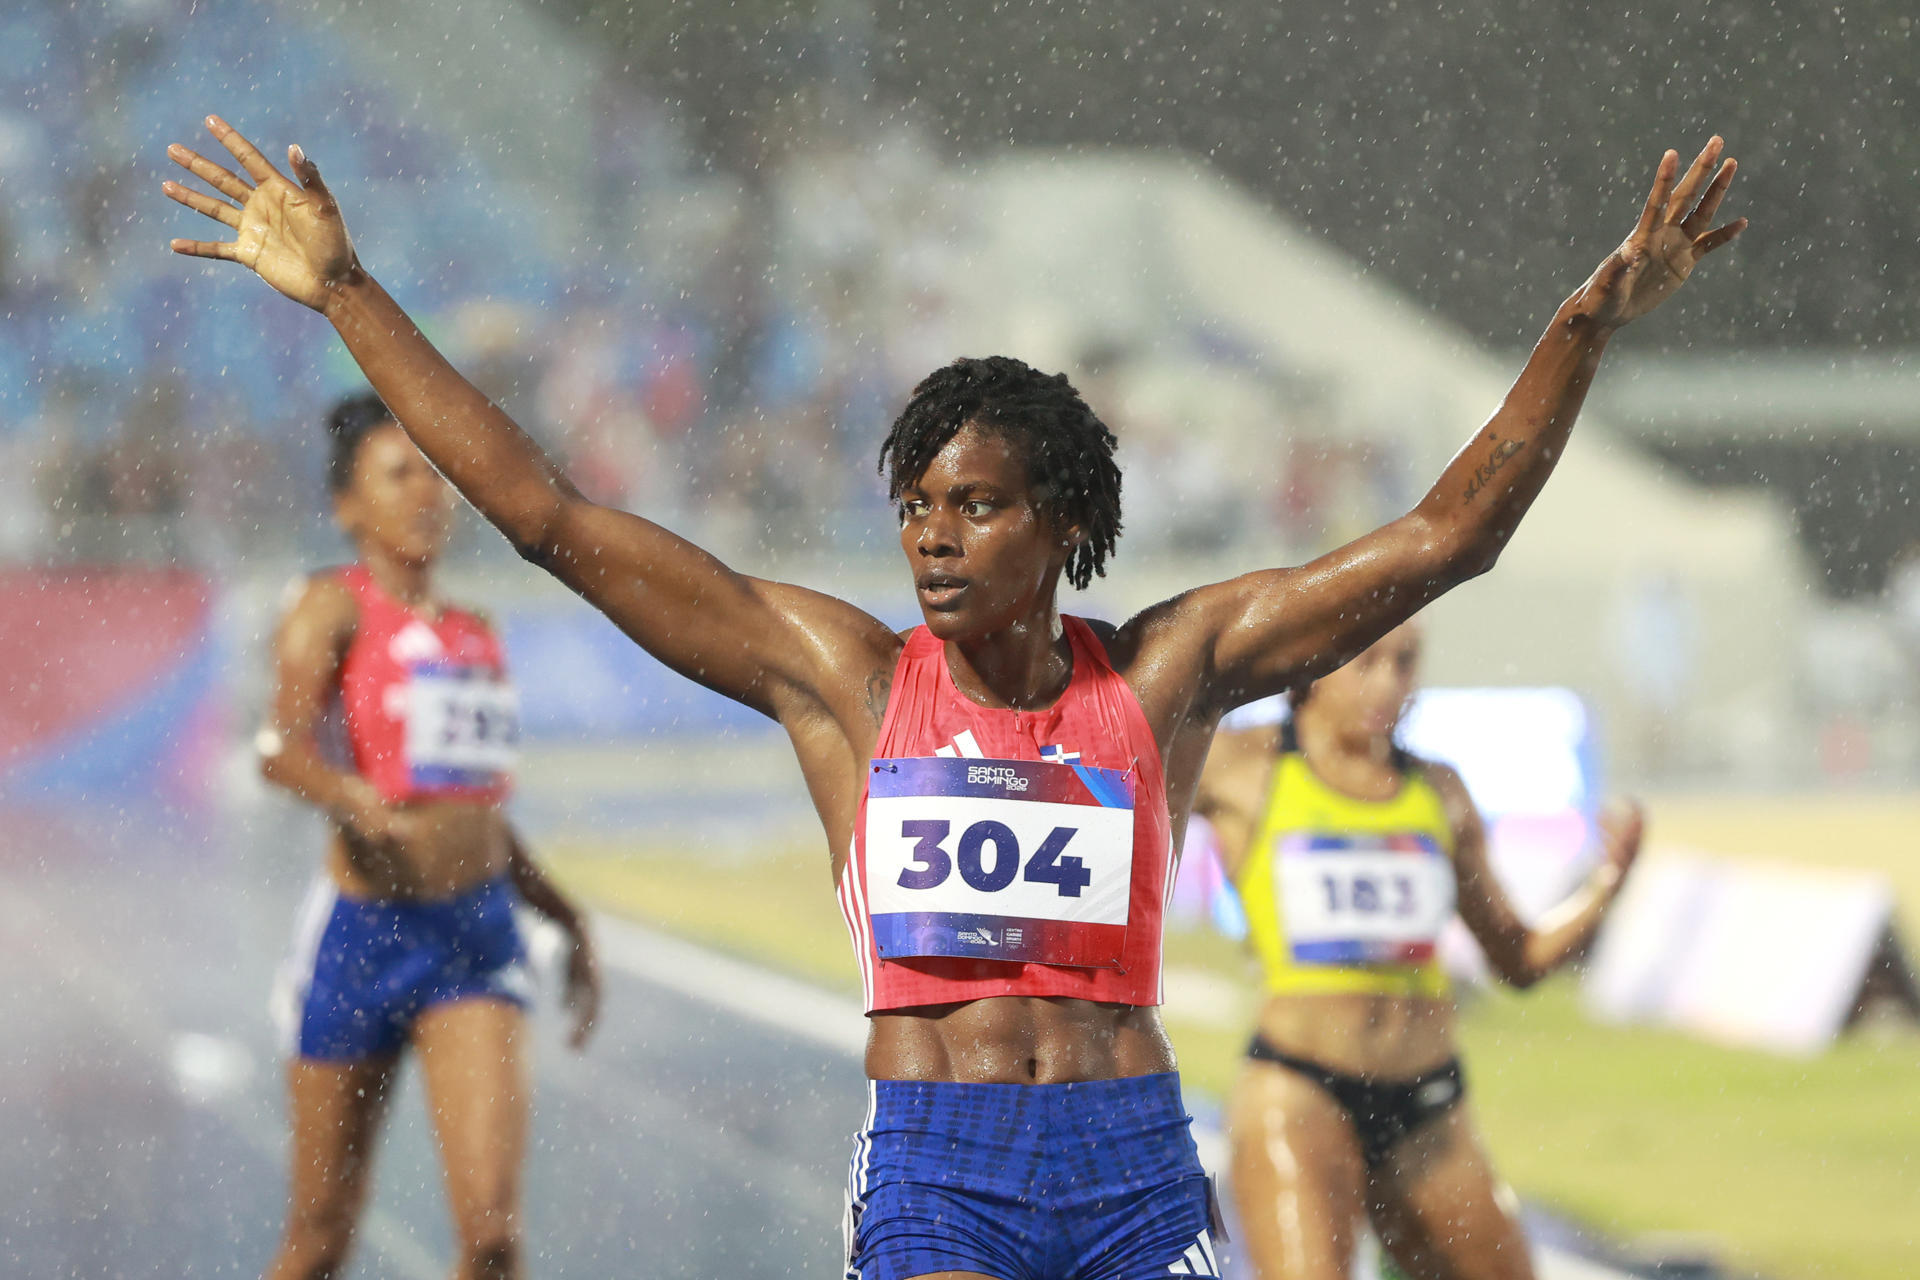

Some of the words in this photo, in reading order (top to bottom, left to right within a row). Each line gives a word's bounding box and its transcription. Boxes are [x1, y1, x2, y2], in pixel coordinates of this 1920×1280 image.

[968, 766, 1015, 777] SANTO
[967, 774, 1029, 787] DOMINGO
[897, 820, 1091, 897] 304
